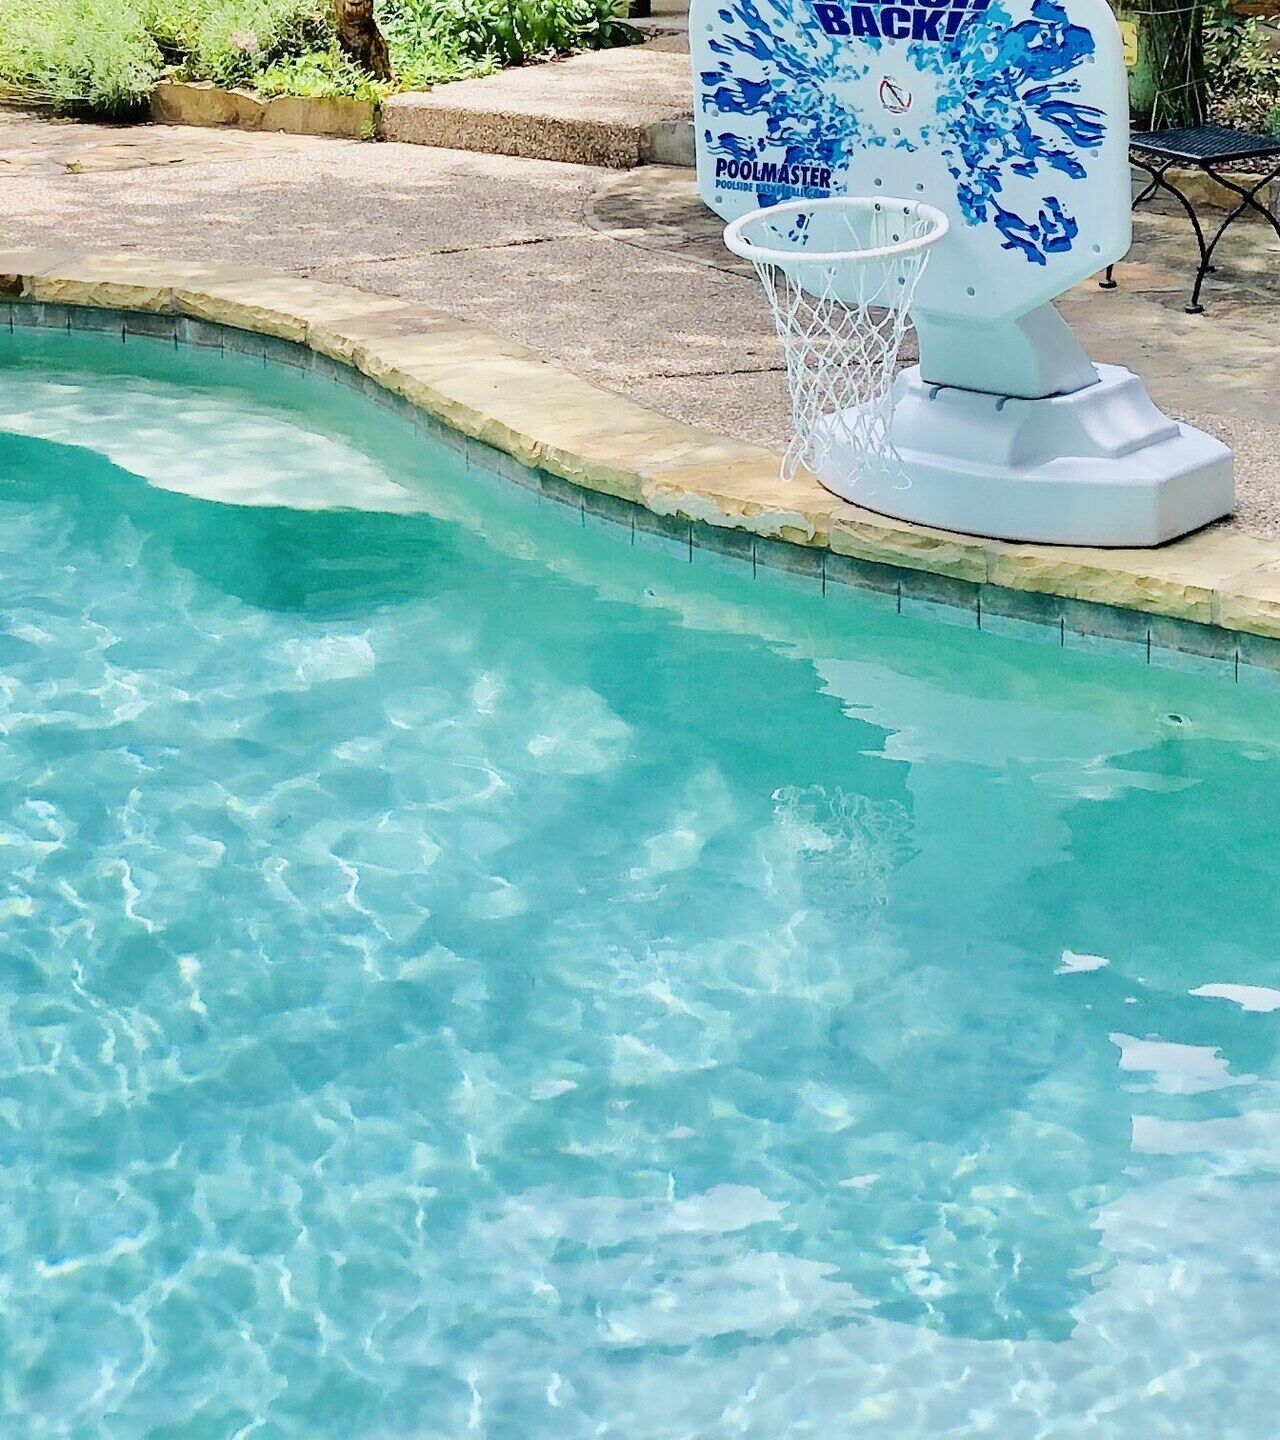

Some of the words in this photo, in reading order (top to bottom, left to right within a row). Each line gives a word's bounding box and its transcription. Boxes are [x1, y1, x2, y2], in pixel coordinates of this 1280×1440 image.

[813, 3, 964, 41] BACK!
[715, 157, 832, 188] POOLMASTER
[715, 179, 753, 192] POOLSIDE
